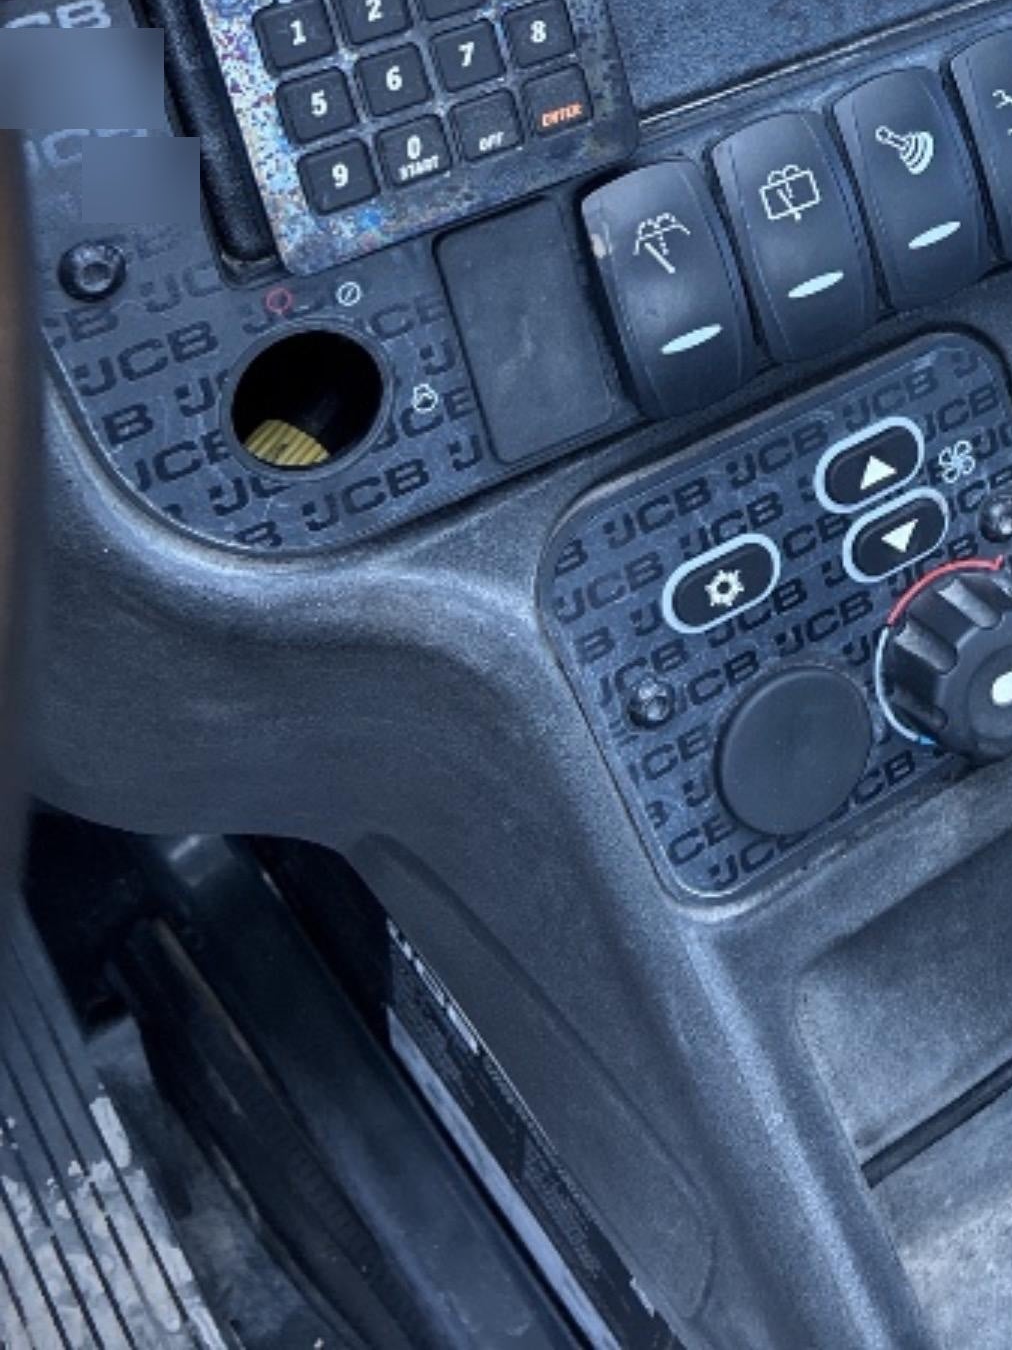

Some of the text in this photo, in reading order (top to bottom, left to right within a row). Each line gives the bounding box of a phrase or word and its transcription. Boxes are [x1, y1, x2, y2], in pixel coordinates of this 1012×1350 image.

[290, 20, 307, 47] 1
[530, 20, 547, 44] 8
[458, 42, 475, 67] 7
[386, 66, 403, 91] 6
[311, 91, 328, 117] 5
[542, 103, 582, 127] ENTER
[407, 135, 422, 159] 0
[479, 132, 504, 151] OFF
[332, 163, 349, 189] 9
[399, 155, 439, 181] START
[73, 321, 218, 397] JCB
[843, 365, 939, 429] JCB
[725, 420, 829, 488] JCB
[302, 459, 430, 531] JCB
[603, 477, 712, 549] JCB
[782, 512, 851, 560] CB
[552, 551, 664, 625] JCB
[773, 590, 874, 655] JCB
[668, 814, 738, 867] CB
